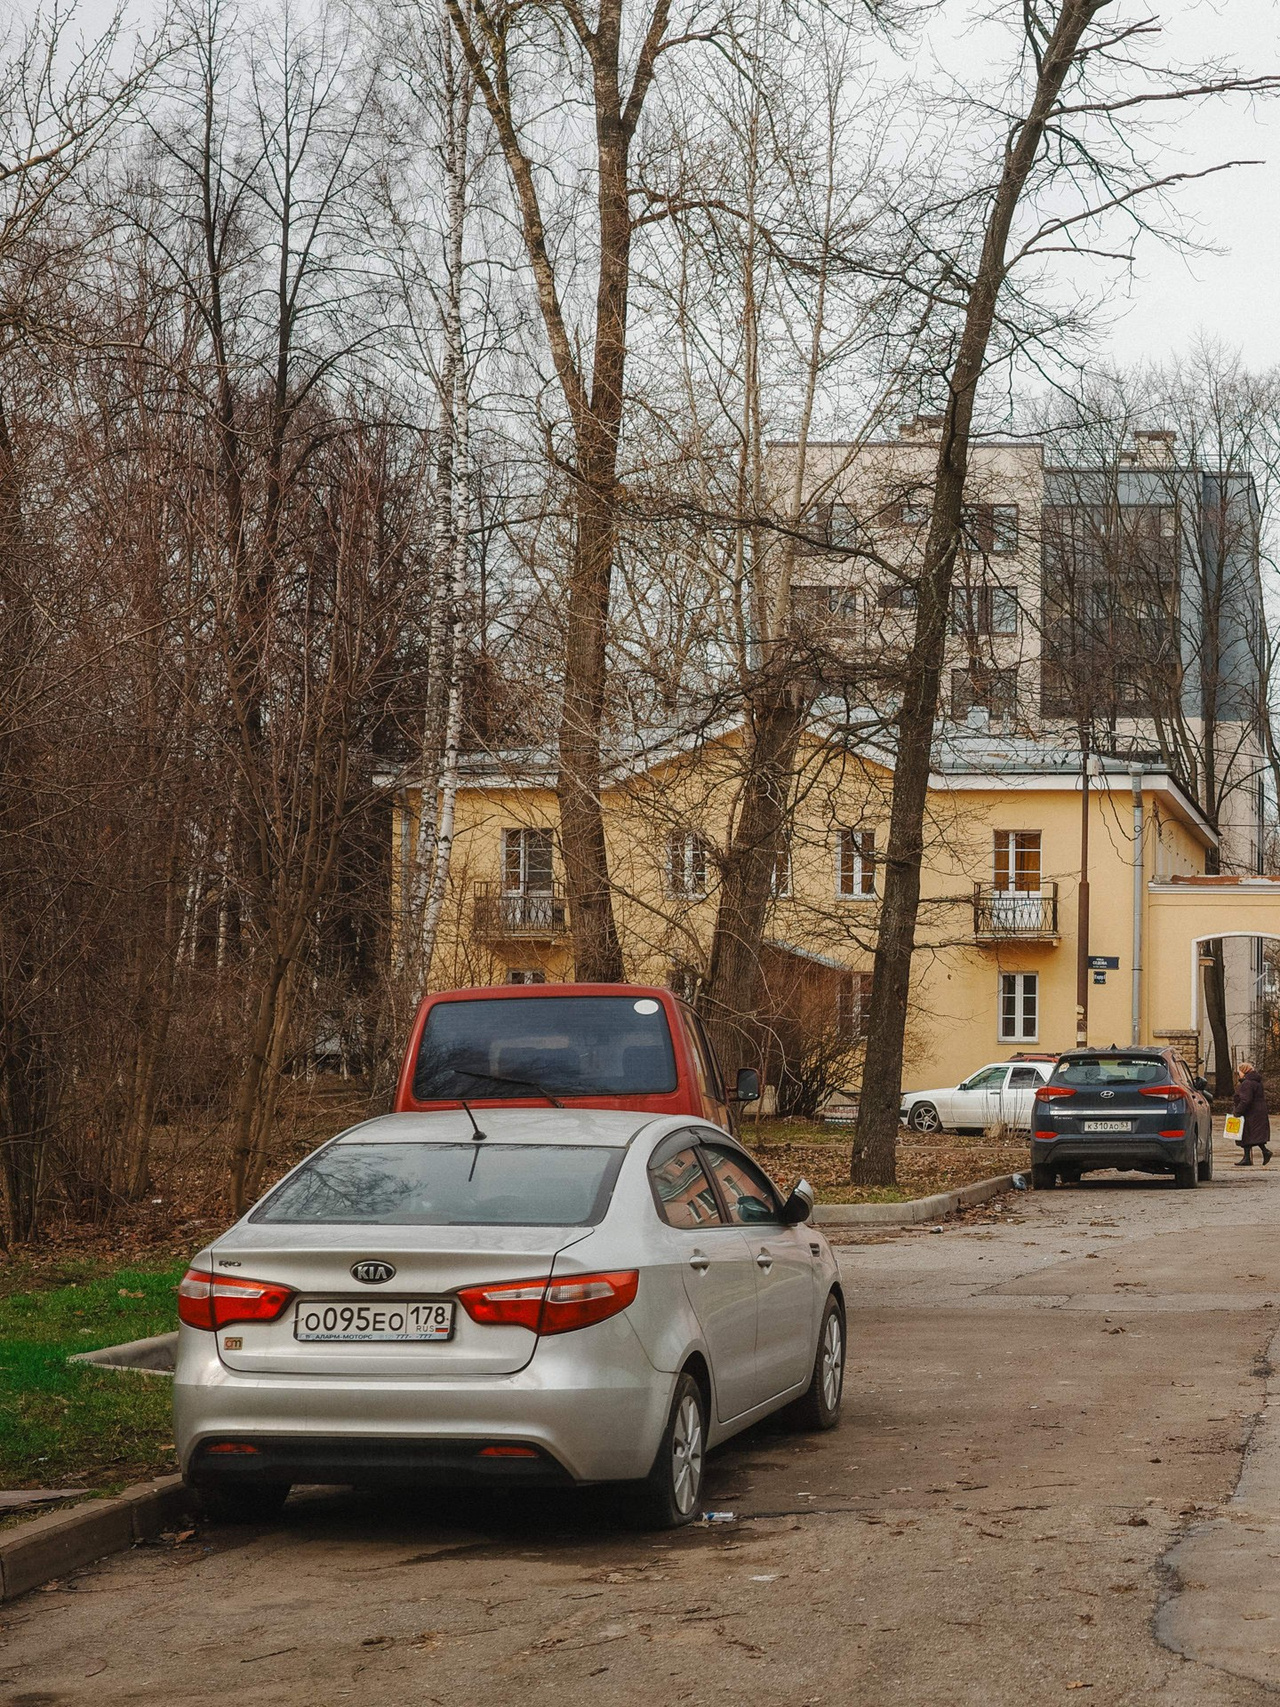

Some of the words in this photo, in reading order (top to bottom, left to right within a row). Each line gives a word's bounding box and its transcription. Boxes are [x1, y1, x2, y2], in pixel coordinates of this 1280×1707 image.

[357, 1266, 388, 1280] KIA
[305, 1306, 404, 1332] О095ЕО
[409, 1305, 446, 1325] 178
[416, 1325, 435, 1333] RUS
